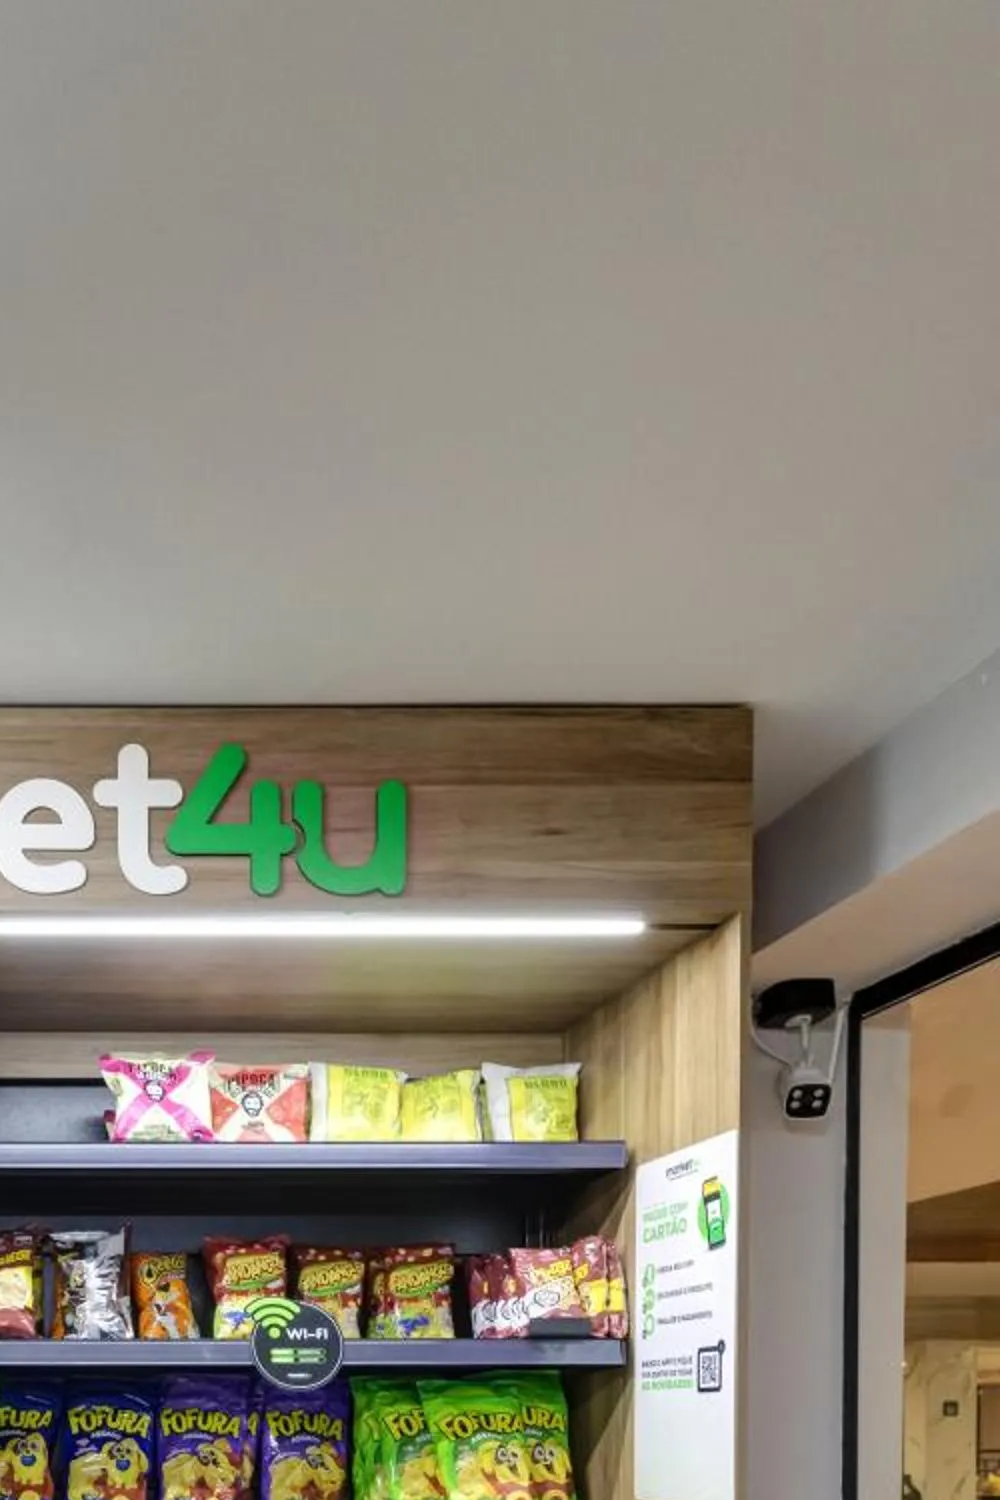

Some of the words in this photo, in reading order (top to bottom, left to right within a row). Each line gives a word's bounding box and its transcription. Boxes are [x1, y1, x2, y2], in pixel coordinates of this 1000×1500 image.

[67, 1404, 150, 1434] FOFURA
[160, 1407, 241, 1437] FOFURA
[265, 1410, 344, 1441] FOFURA
[435, 1411, 523, 1442] FOFURA
[521, 1405, 566, 1433] URA
